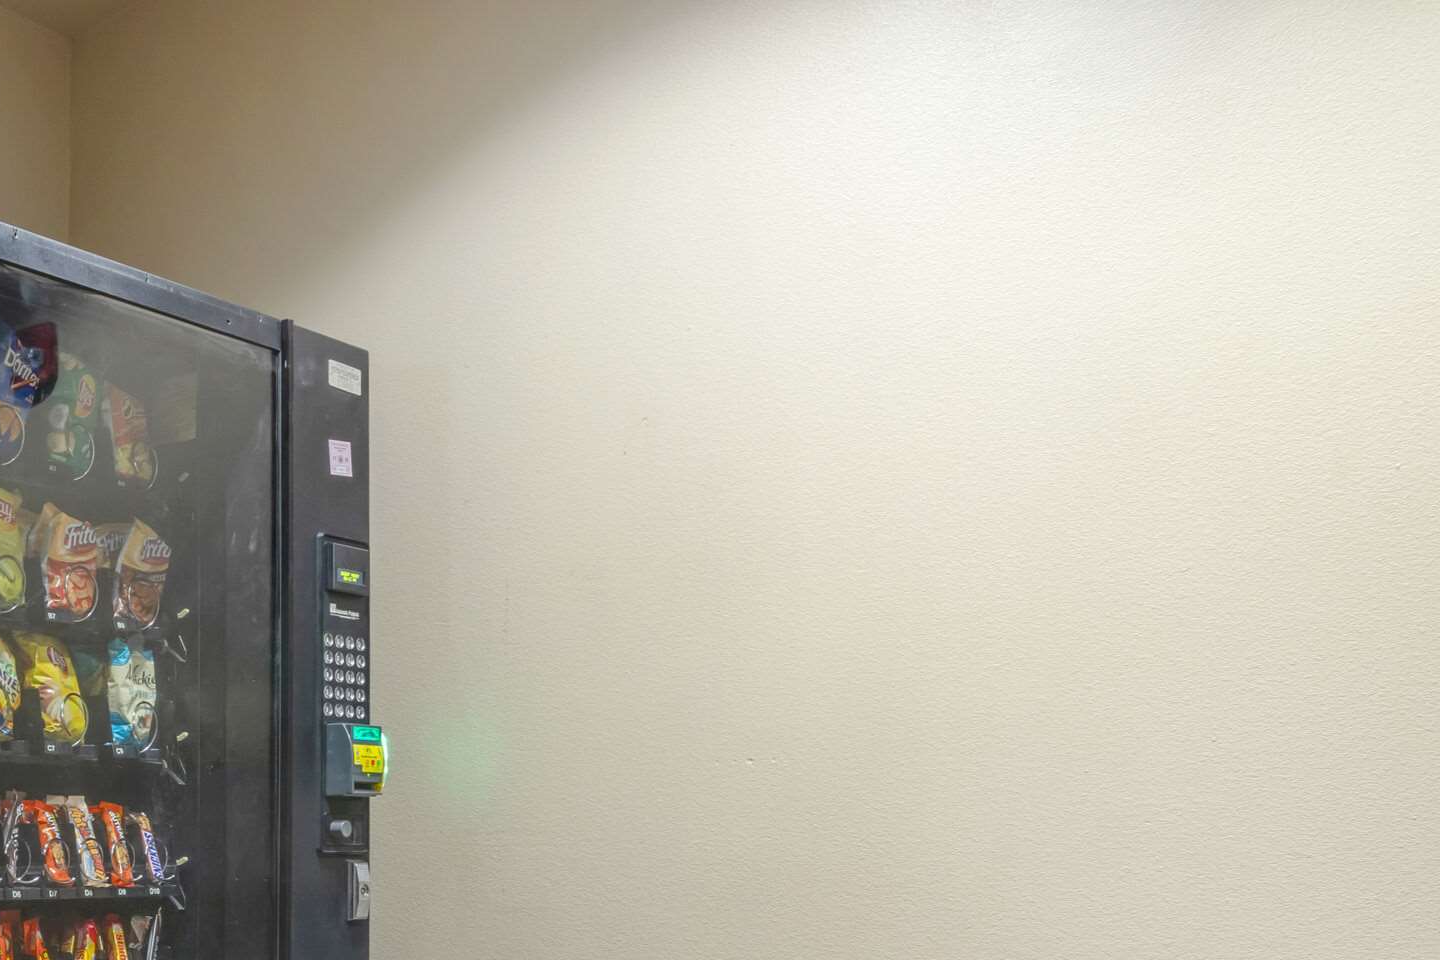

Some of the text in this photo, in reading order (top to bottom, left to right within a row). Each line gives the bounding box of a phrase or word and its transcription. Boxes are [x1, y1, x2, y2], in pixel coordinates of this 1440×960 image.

[64, 524, 97, 549] Frito
[143, 537, 171, 561] Frito
[48, 889, 58, 898] D7
